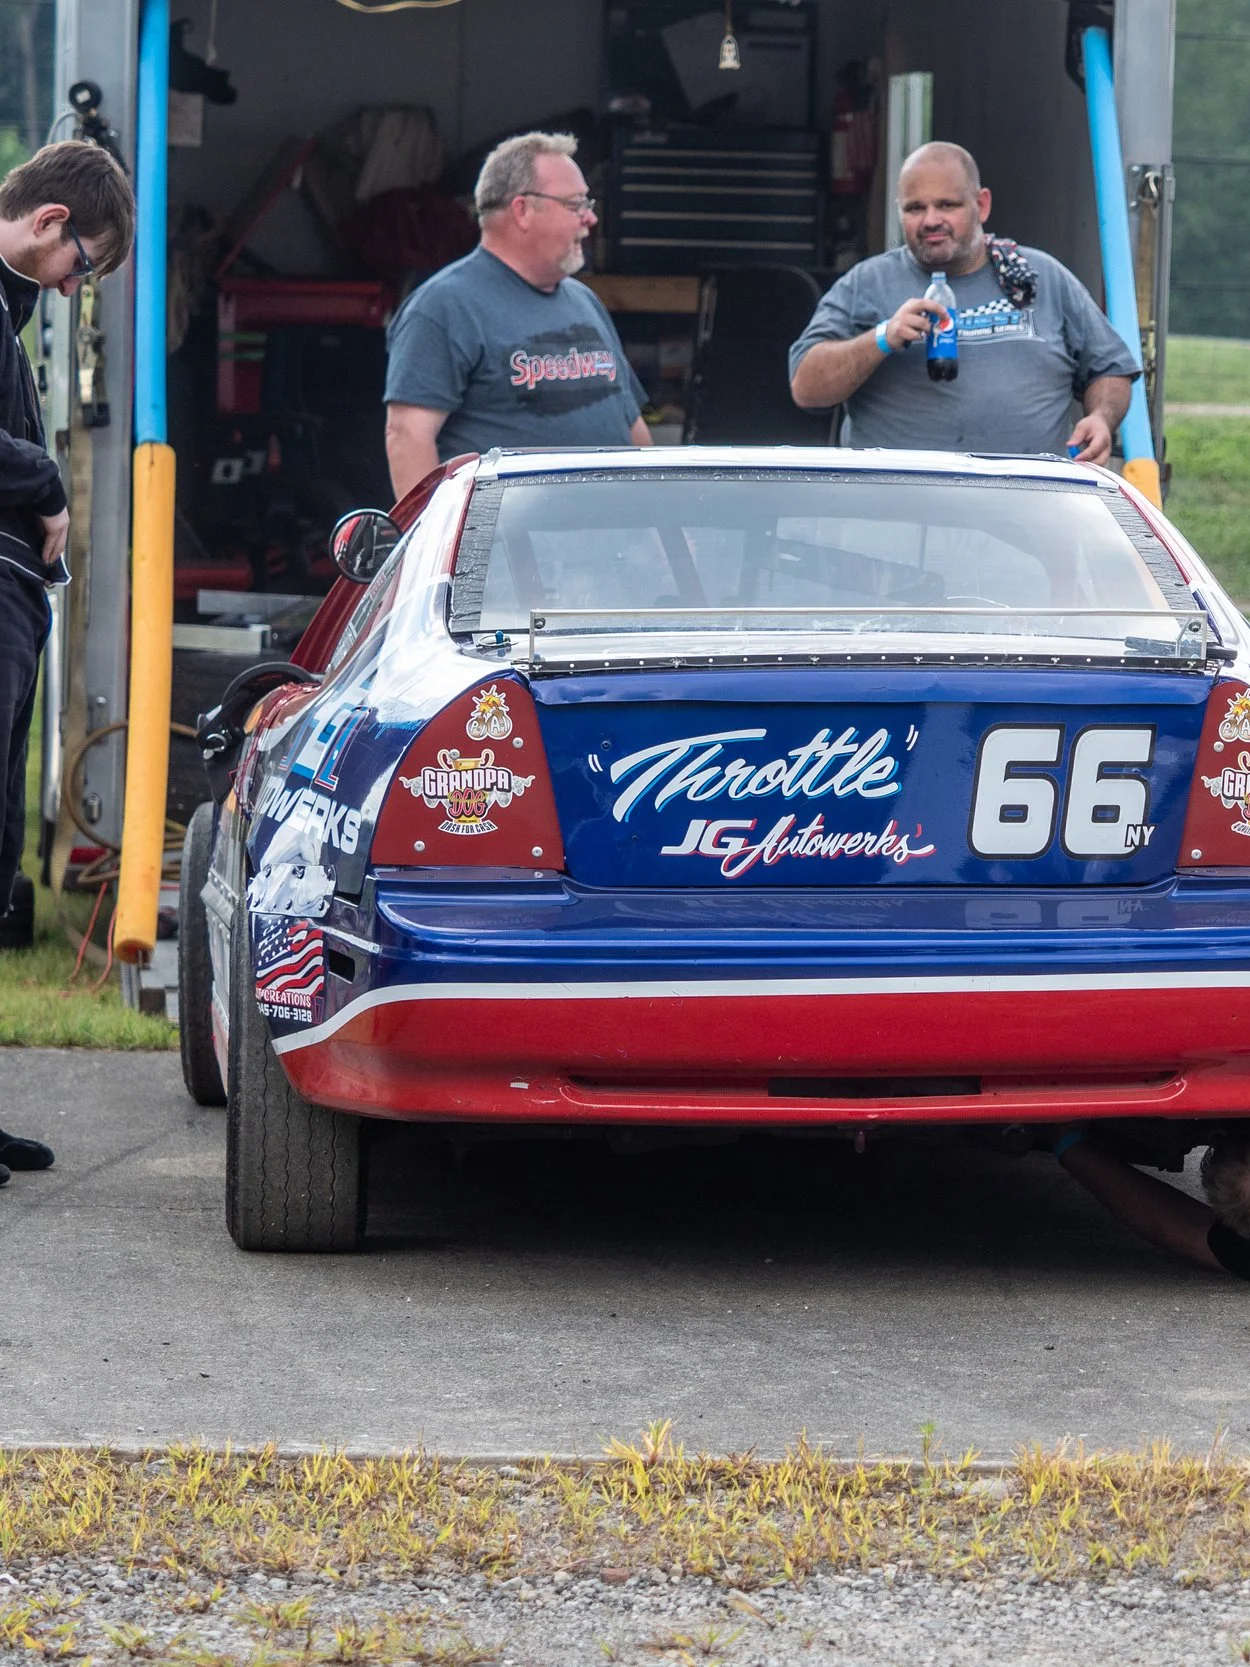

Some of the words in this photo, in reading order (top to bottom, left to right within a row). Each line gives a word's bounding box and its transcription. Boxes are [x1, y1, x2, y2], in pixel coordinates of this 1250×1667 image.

[510, 347, 617, 390] Speedway
[423, 768, 512, 799] GRANDPA
[968, 722, 1157, 861] 66
[448, 787, 487, 817] DOG
[440, 821, 461, 834] DASH
[461, 824, 475, 834] FOR
[475, 821, 496, 834] CASH
[1124, 823, 1156, 848] NY
[263, 989, 312, 1008] CREATIONS
